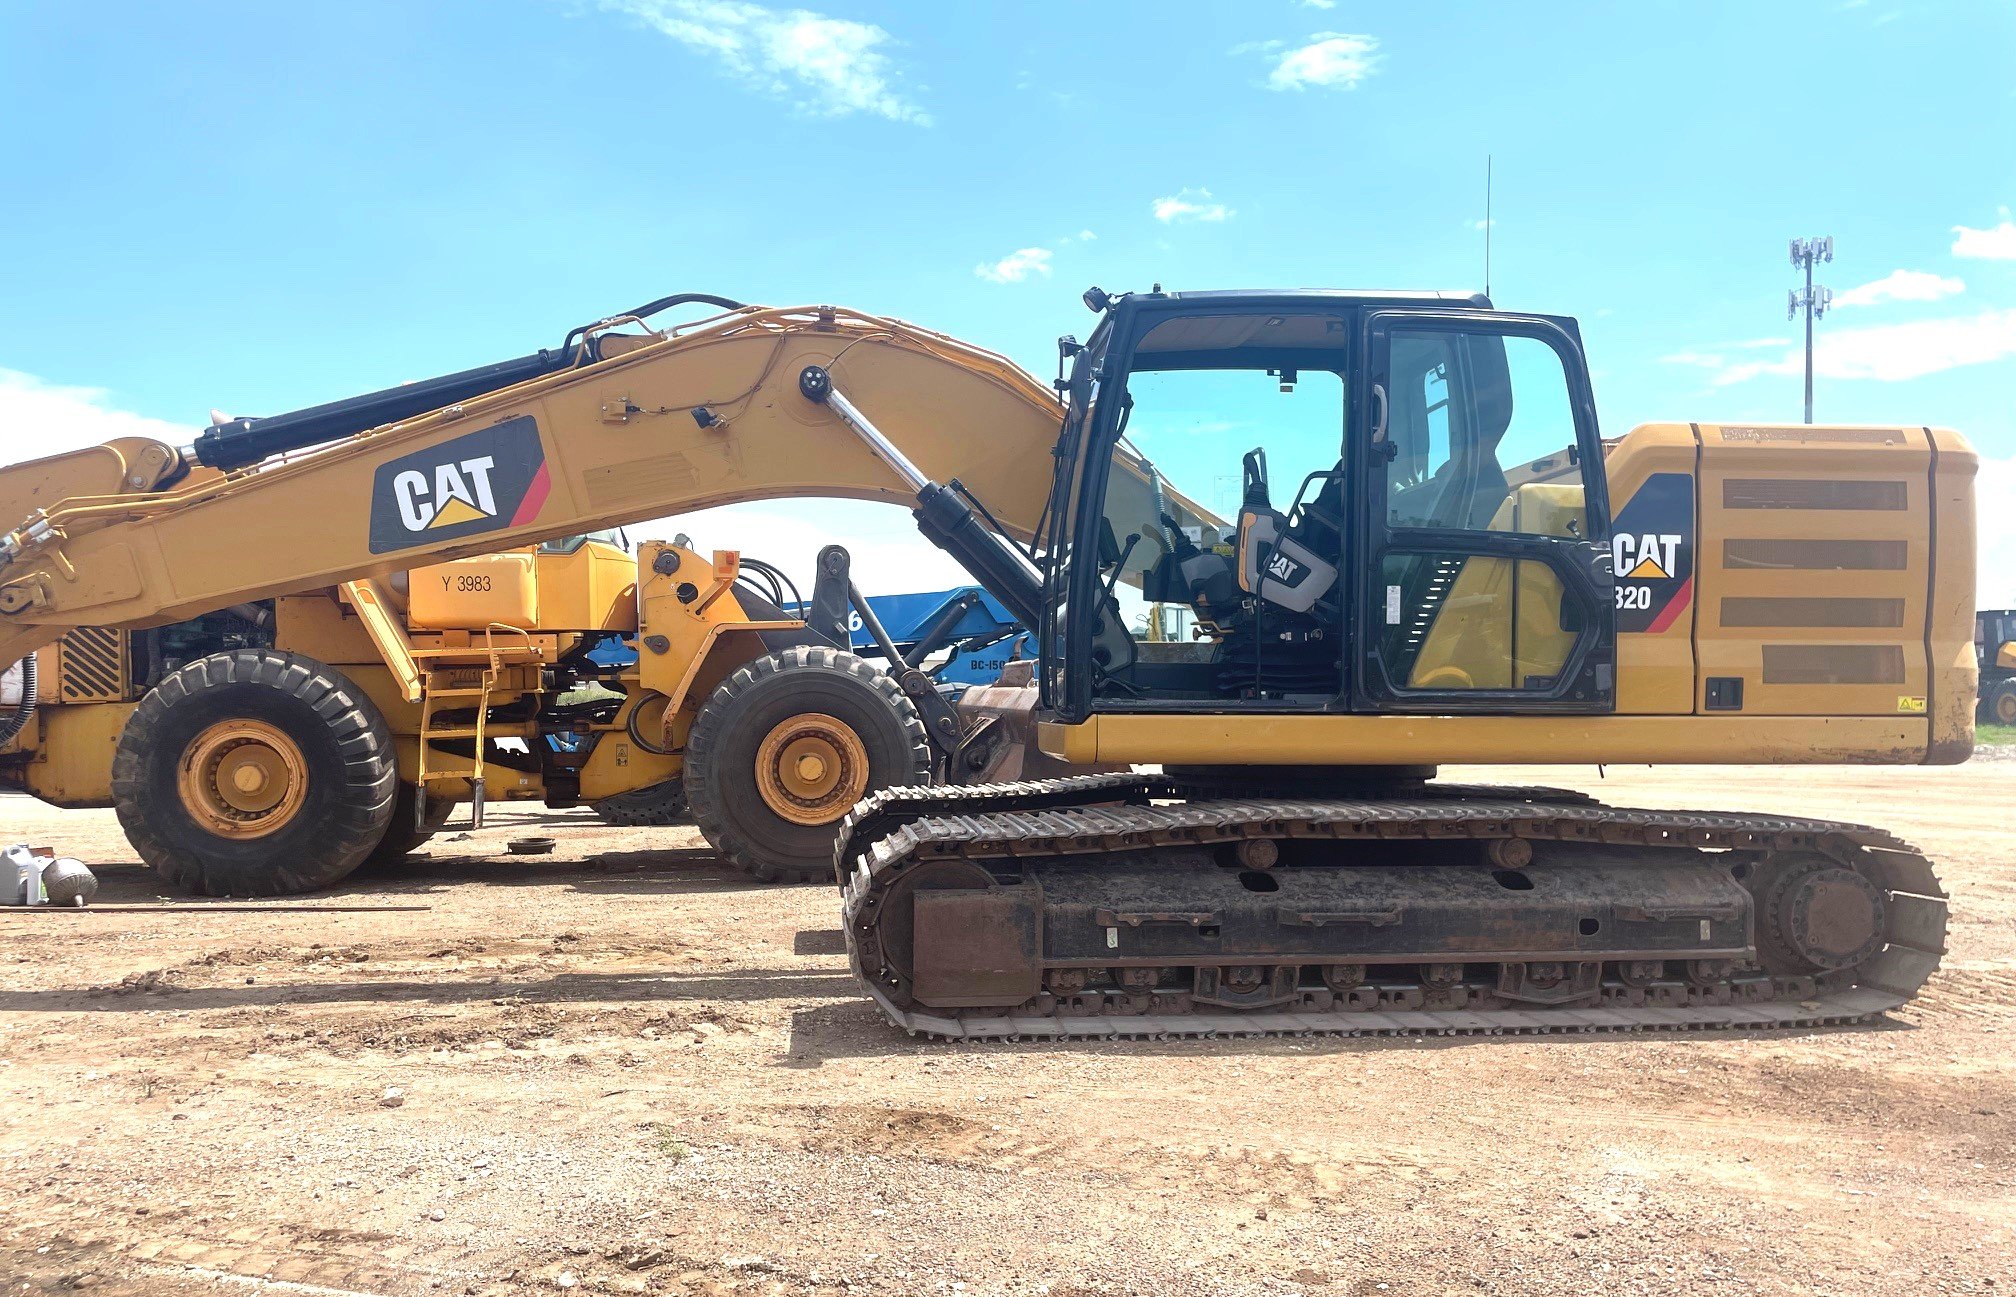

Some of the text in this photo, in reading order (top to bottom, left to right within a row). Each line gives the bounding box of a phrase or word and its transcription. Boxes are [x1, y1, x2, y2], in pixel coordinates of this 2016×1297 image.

[393, 455, 498, 532] CAT
[1612, 532, 1682, 578] CAT
[441, 575, 491, 591] Y 3983
[1614, 586, 1651, 610] 320
[848, 609, 863, 632] 6
